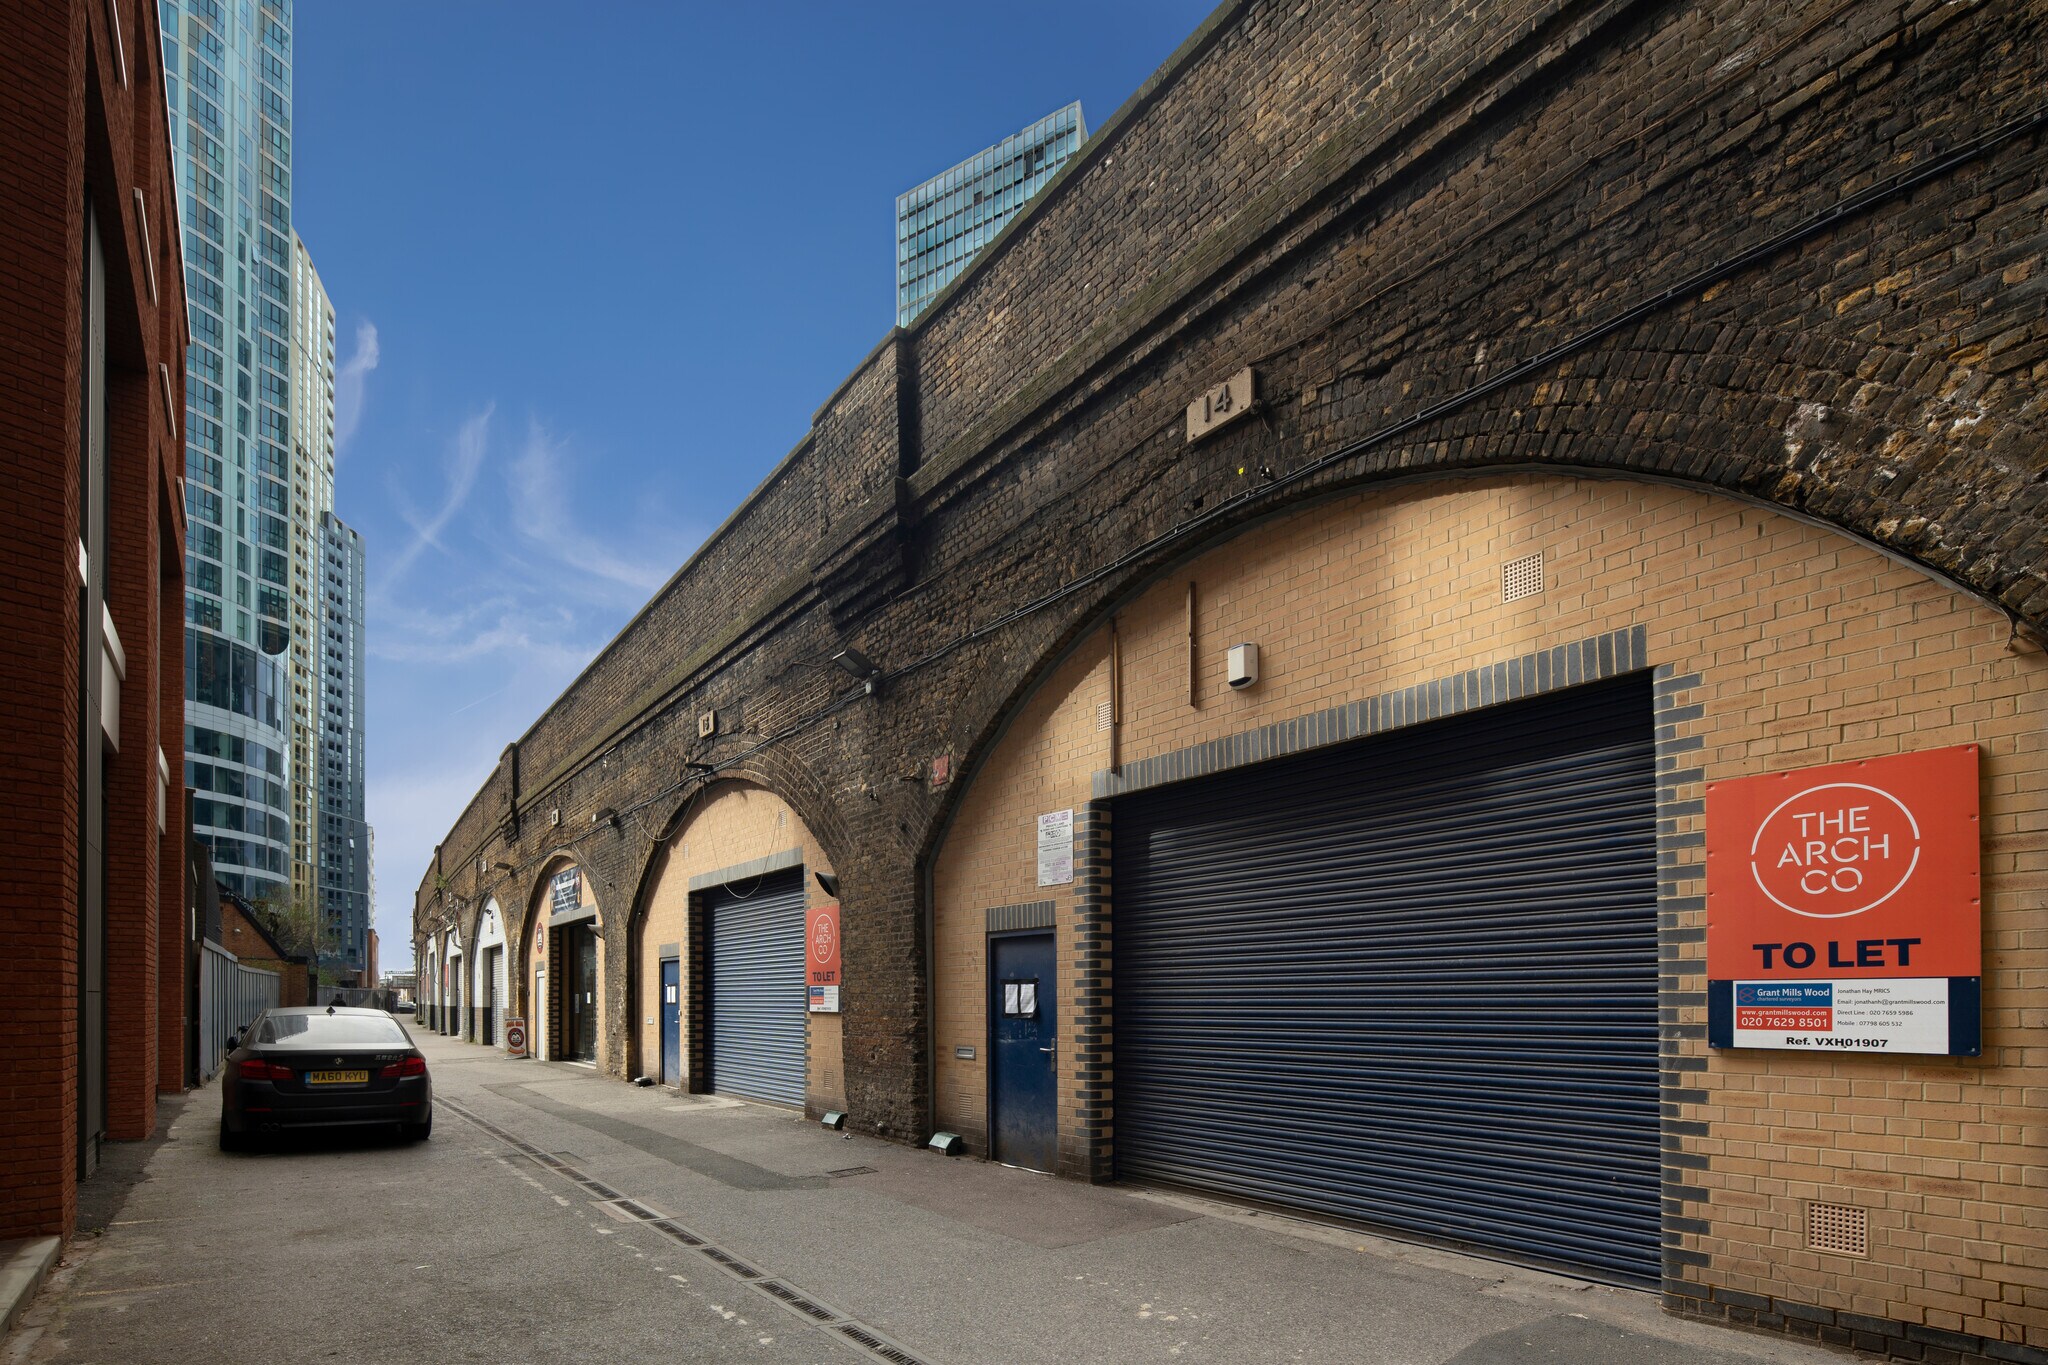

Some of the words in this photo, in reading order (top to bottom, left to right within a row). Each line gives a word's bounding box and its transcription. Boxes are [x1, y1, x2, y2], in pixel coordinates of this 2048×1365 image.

[1203, 383, 1231, 423] 14
[1792, 805, 1870, 837] THE
[1777, 833, 1889, 868] ARCH
[1800, 866, 1863, 895] CO
[817, 922, 829, 933] THE
[815, 933, 832, 945] ARCH
[818, 945, 828, 955] CO
[1752, 941, 1816, 969] TO
[1828, 937, 1921, 968] LET
[812, 972, 822, 982] TO
[822, 971, 835, 982] LET
[1757, 988, 1780, 997] Grant
[1782, 988, 1803, 997] Mills
[1804, 987, 1830, 997] Wood
[1853, 998, 1946, 1006] jonathanh@grantmillswood.com
[1741, 1009, 1828, 1017] www.grantmillswood.com
[1741, 1017, 1765, 1027] 020
[1766, 1017, 1795, 1027] 7629
[1799, 1018, 1828, 1028] 8501
[1786, 1036, 1811, 1046] Ref.
[1815, 1038, 1889, 1048] VXH01907
[312, 1071, 342, 1082] MA60
[344, 1071, 367, 1081] KYU
